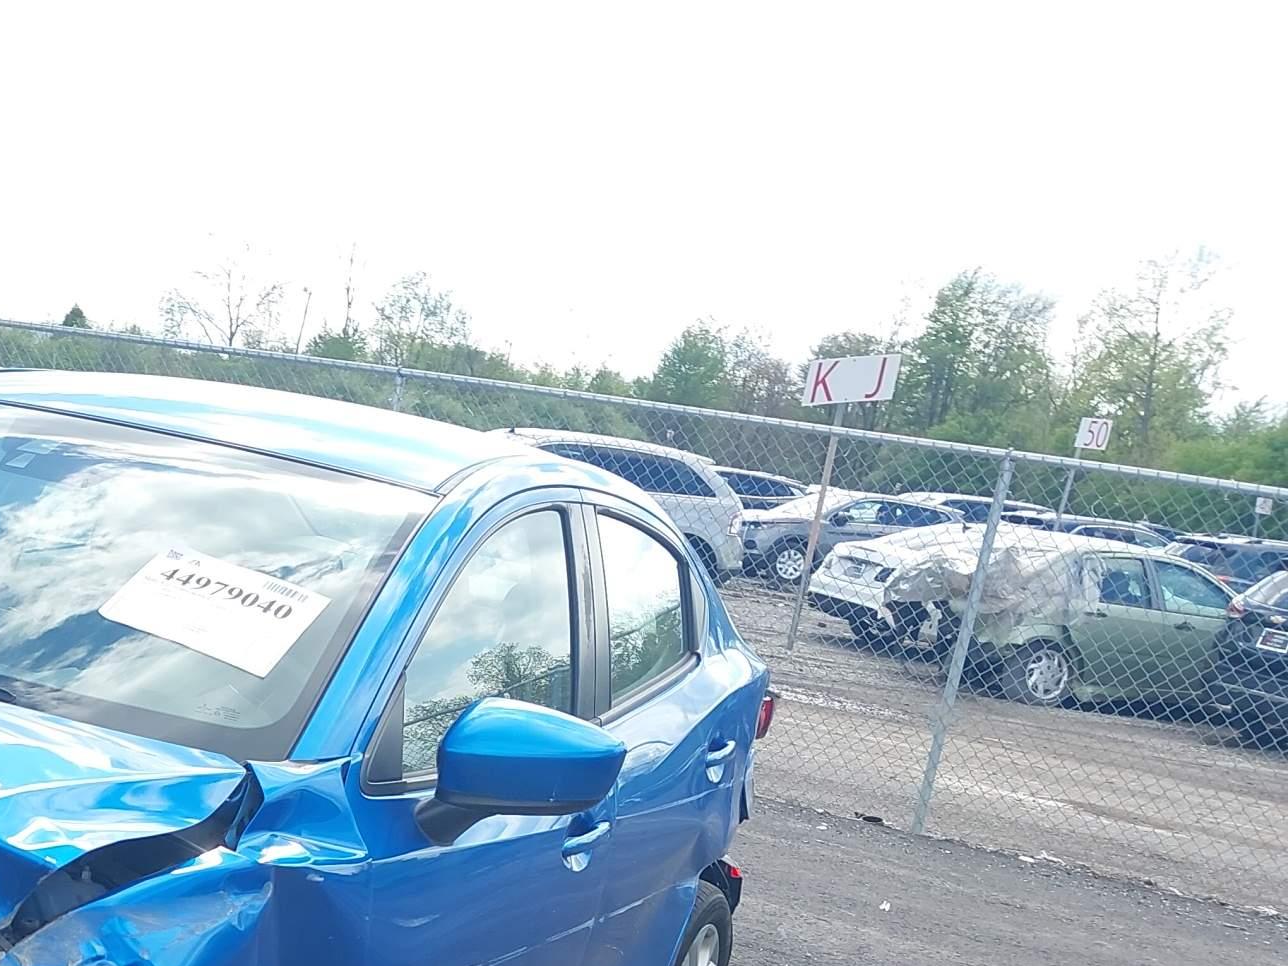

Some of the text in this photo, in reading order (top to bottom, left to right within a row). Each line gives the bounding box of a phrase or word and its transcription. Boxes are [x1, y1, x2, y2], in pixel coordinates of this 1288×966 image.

[811, 356, 888, 403] K J
[1082, 420, 1109, 448] 50
[160, 568, 293, 620] 44979040
